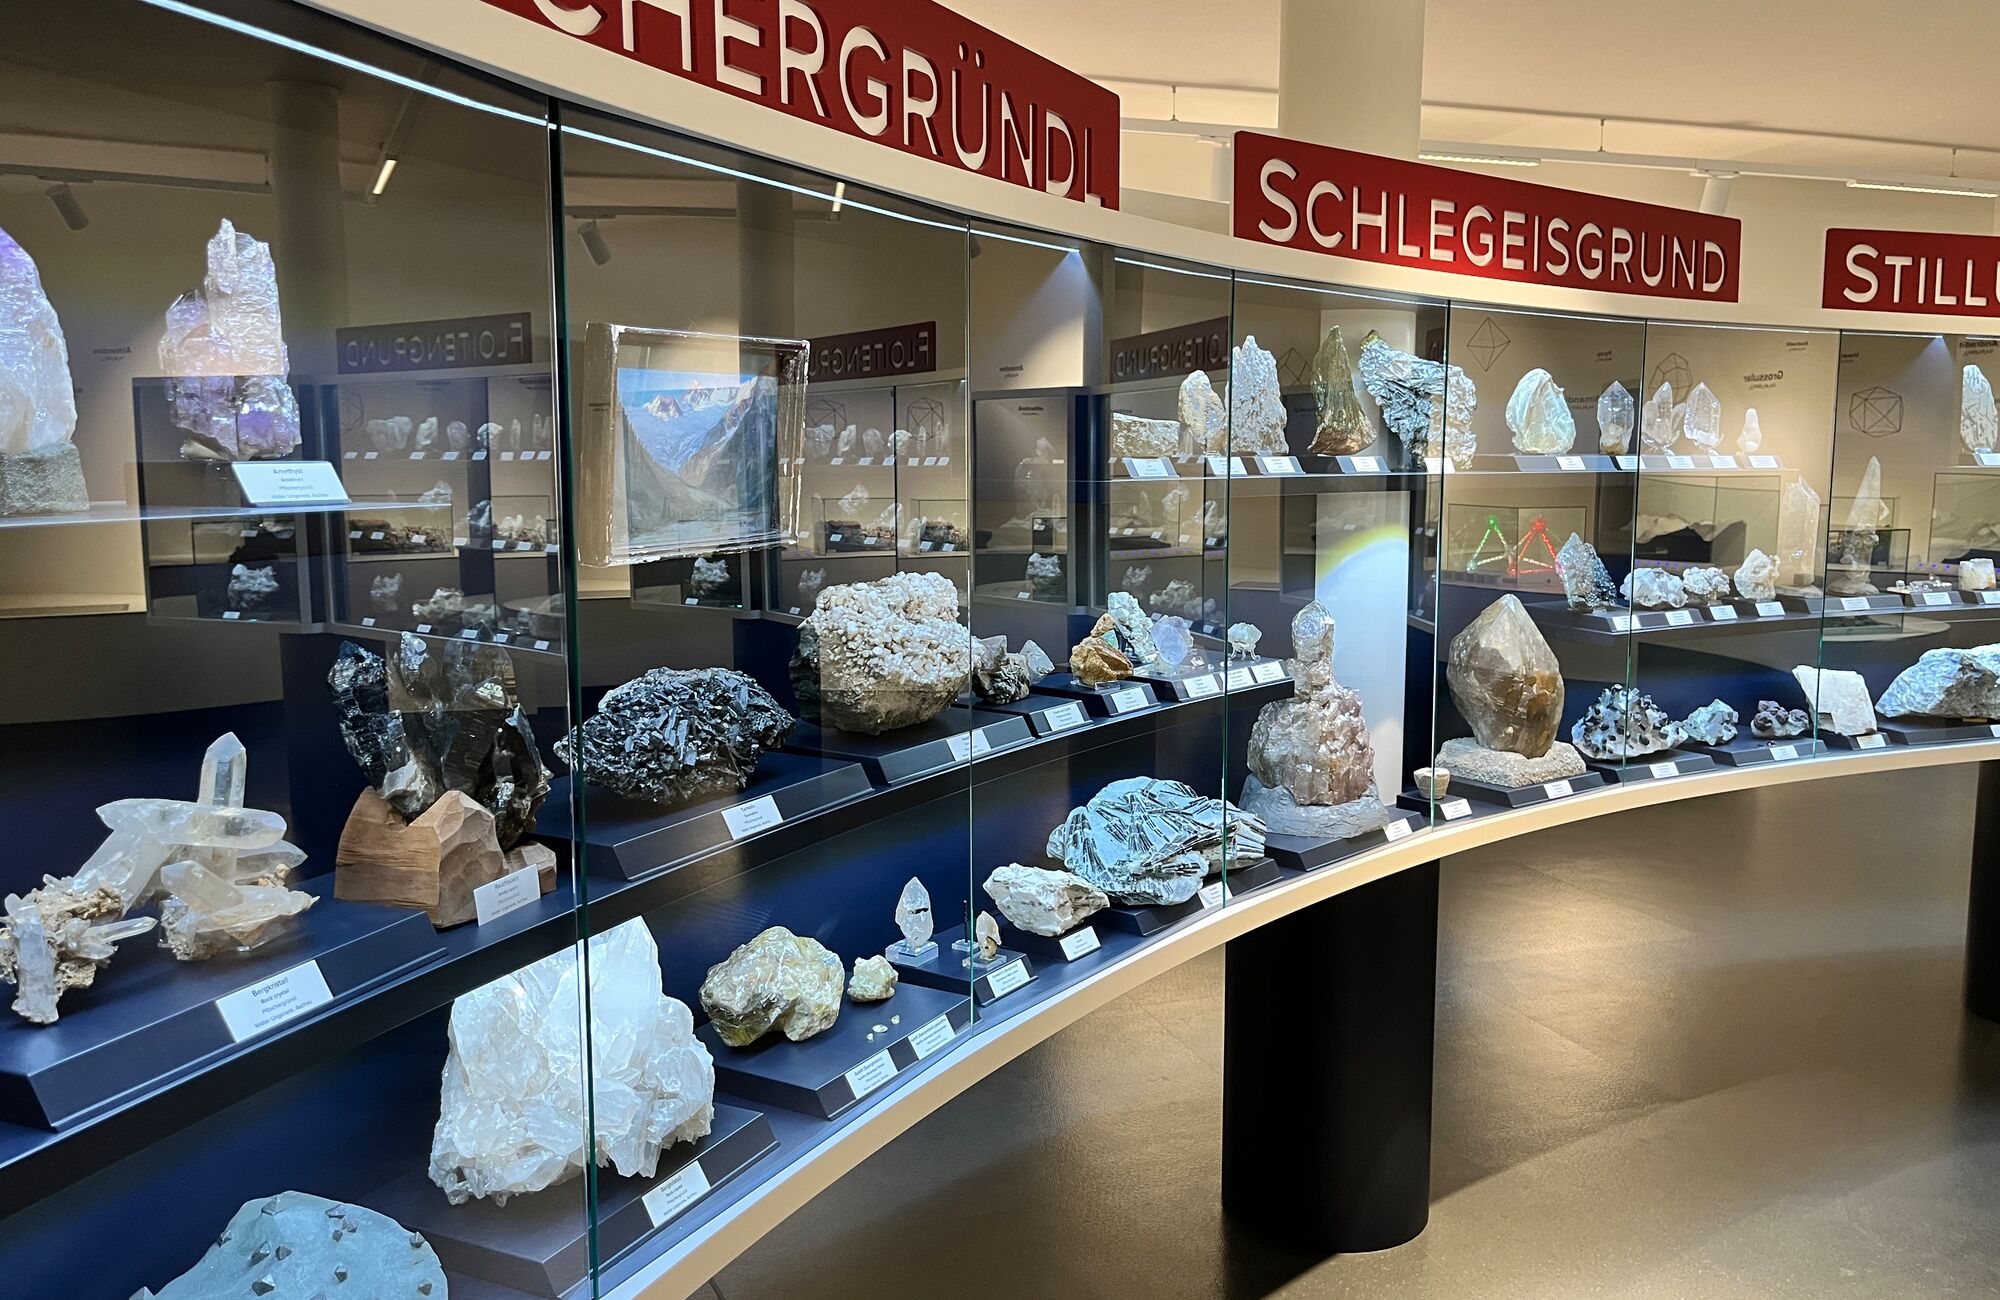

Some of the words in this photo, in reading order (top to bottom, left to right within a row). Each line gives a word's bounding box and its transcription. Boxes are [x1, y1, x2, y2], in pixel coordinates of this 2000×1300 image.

[1258, 158, 1726, 294] SCHLEGEISGRUND
[1842, 243, 2000, 306] STILL
[251, 976, 289, 998] Bergkristall
